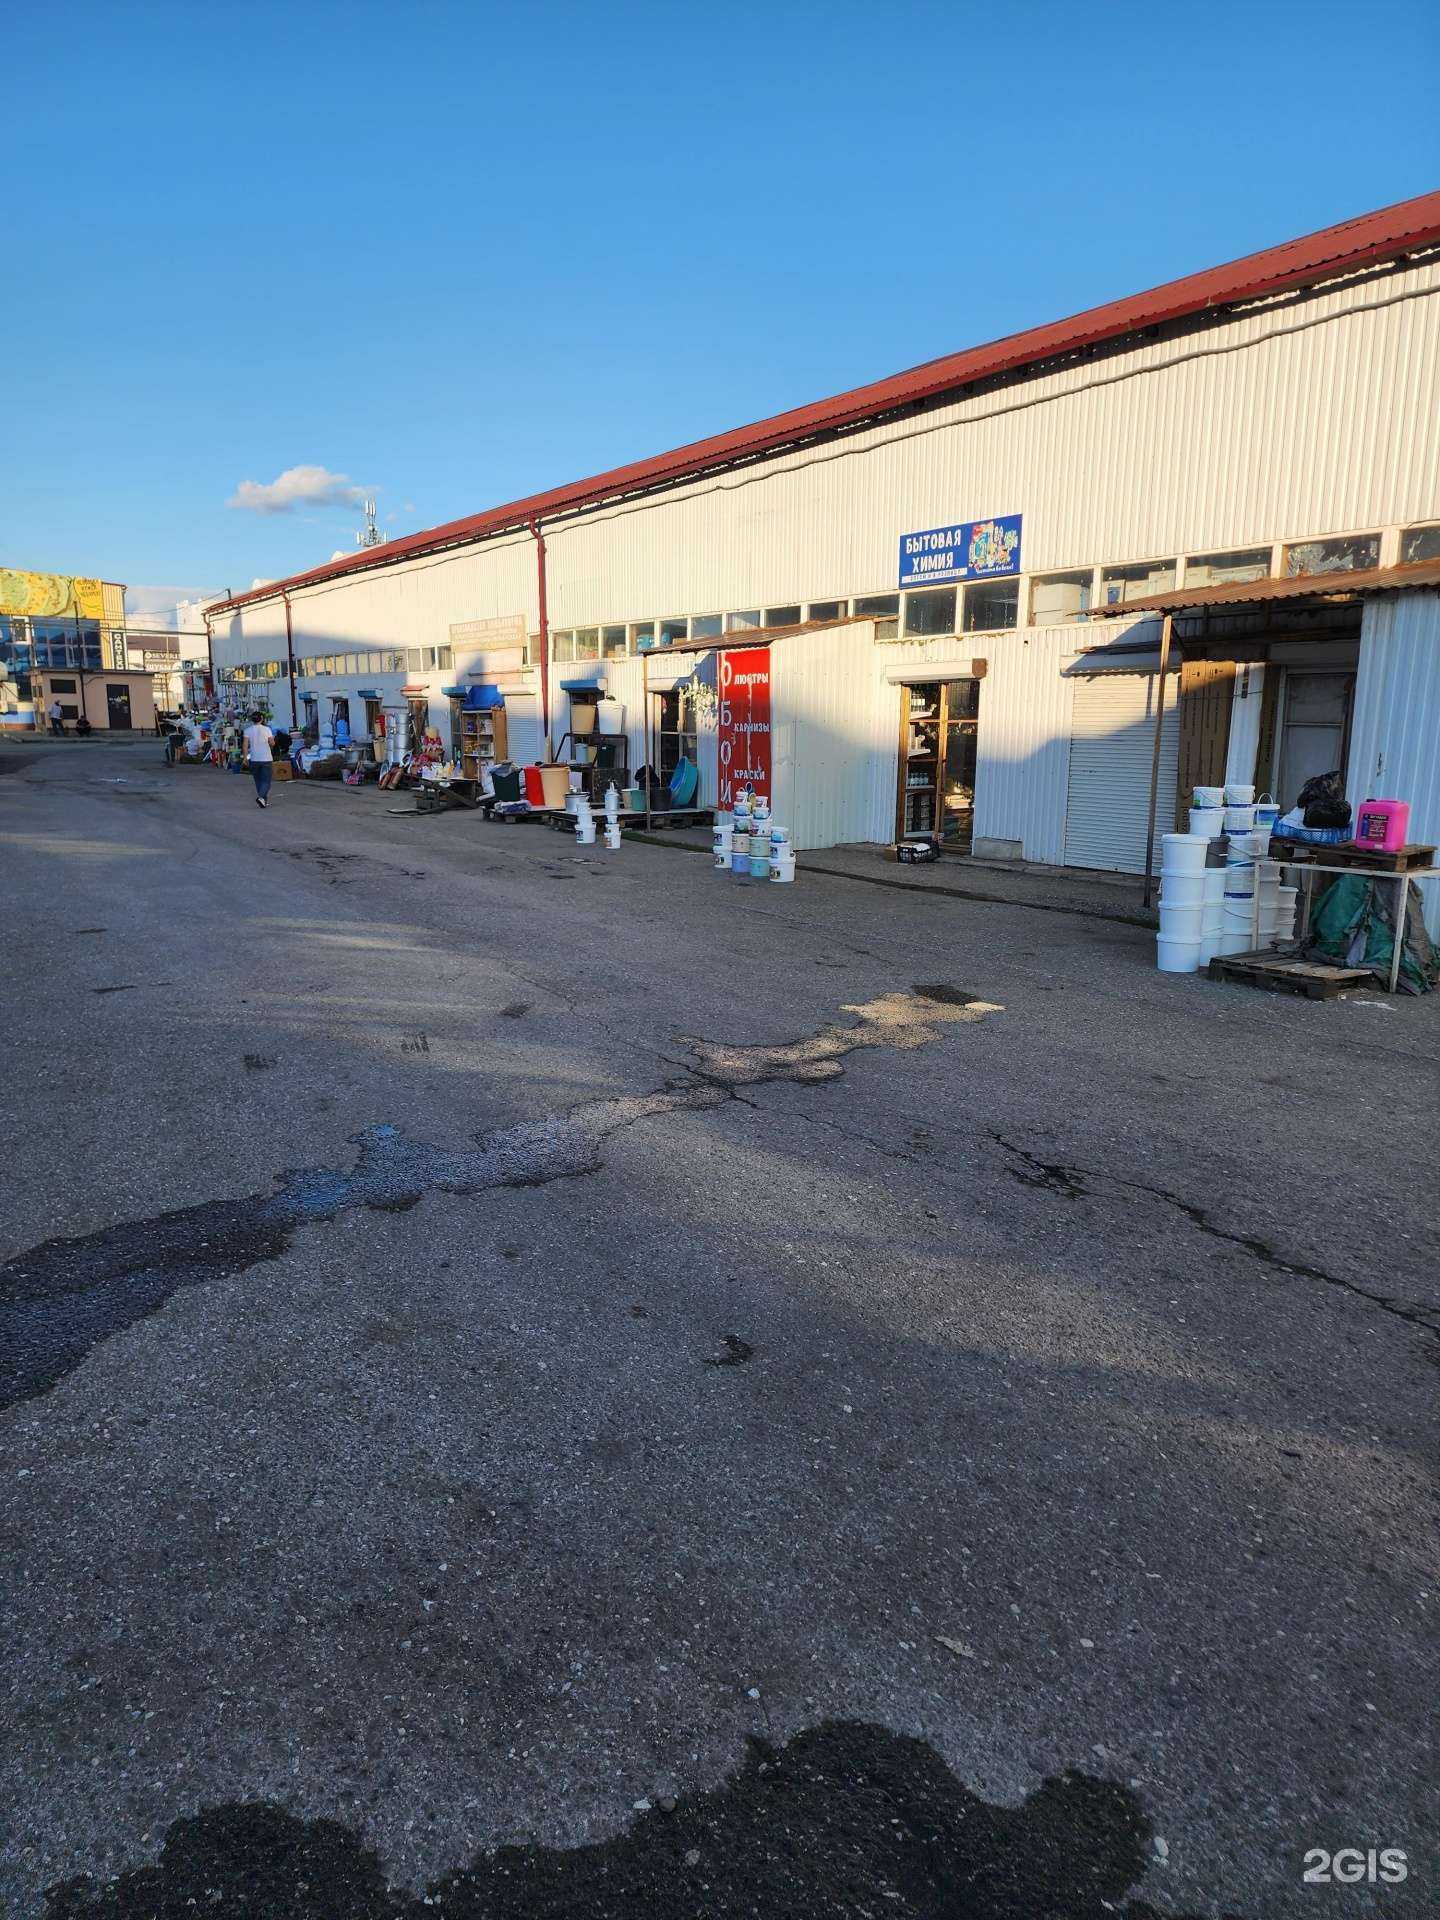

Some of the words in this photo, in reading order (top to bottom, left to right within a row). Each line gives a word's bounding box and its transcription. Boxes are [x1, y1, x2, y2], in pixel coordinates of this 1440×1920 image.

[906, 529, 961, 554] БЫТОВАЯ
[912, 552, 953, 573] ХИМИЯ
[734, 672, 768, 685] ЛЮСТРЫ
[735, 722, 770, 733] КАРНИЗЫ
[734, 769, 765, 780] КРАСКИ
